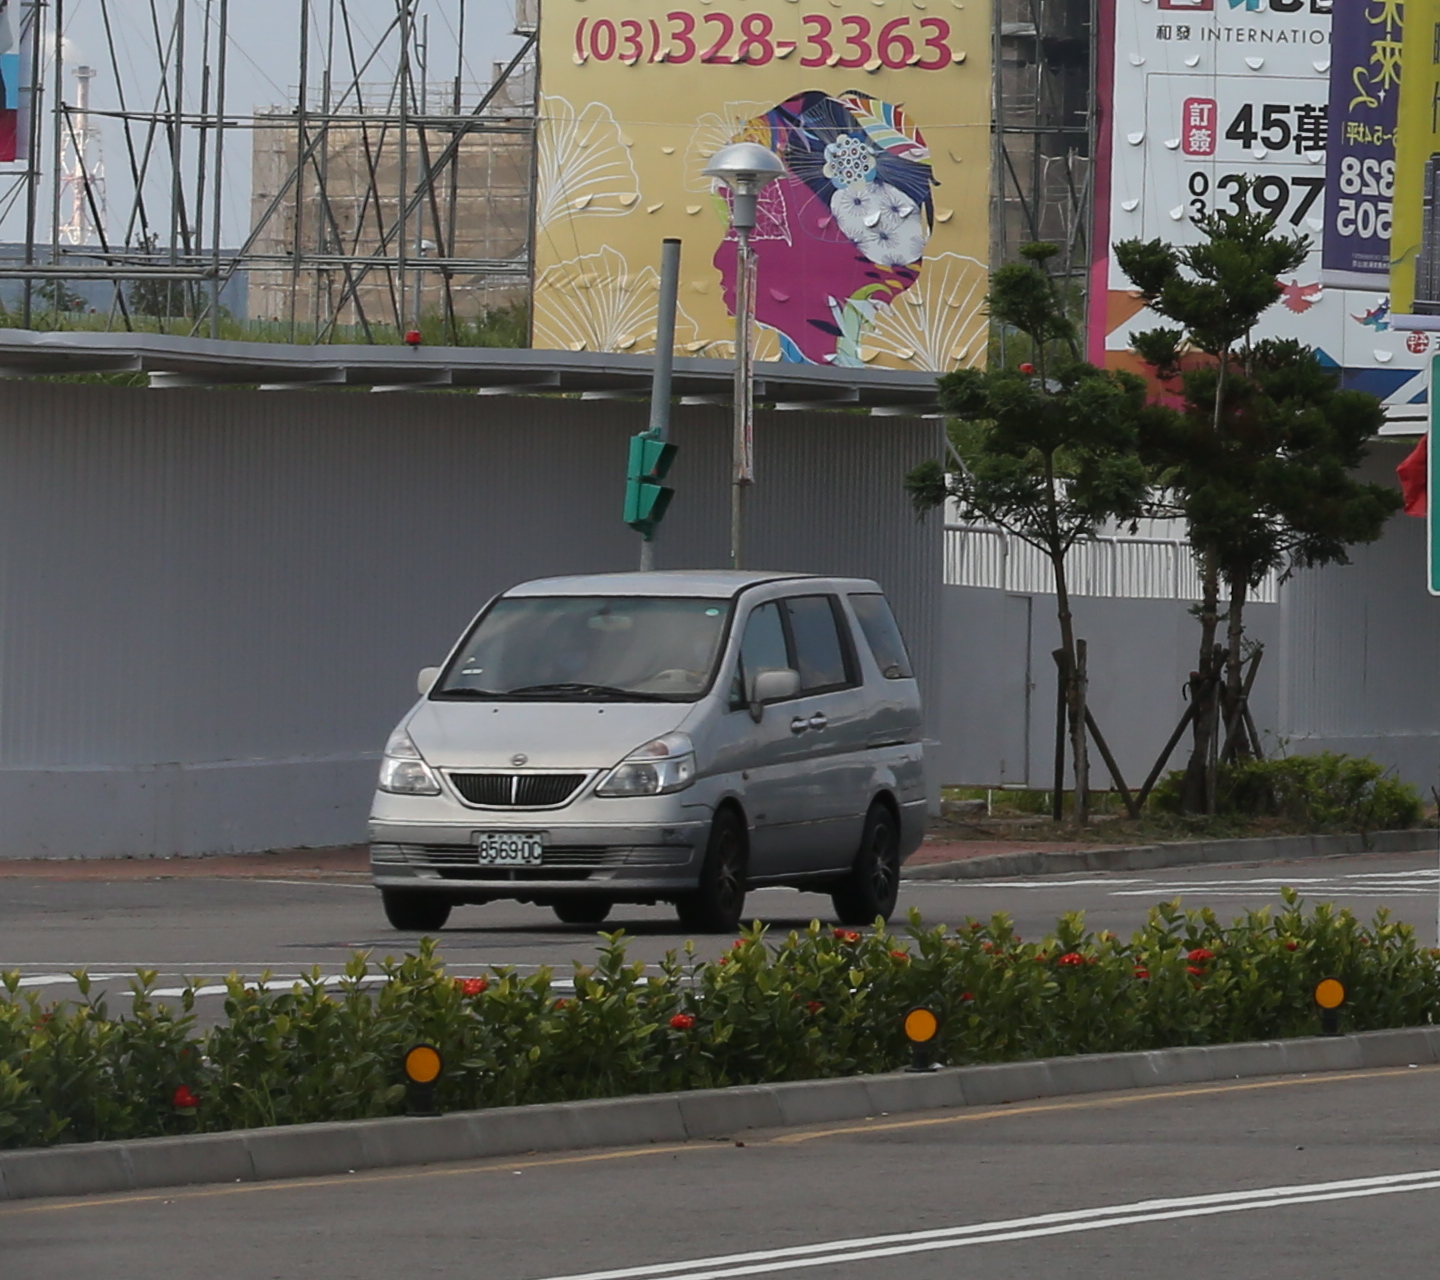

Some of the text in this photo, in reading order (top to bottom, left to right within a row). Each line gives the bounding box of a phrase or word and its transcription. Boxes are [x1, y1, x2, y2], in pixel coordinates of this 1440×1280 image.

[574, 11, 954, 72] (03)328-3363
[1156, 24, 1332, 45] 和發 INTERNATIO
[1225, 102, 1329, 155] 45萬
[480, 840, 542, 860] 8569-DC
